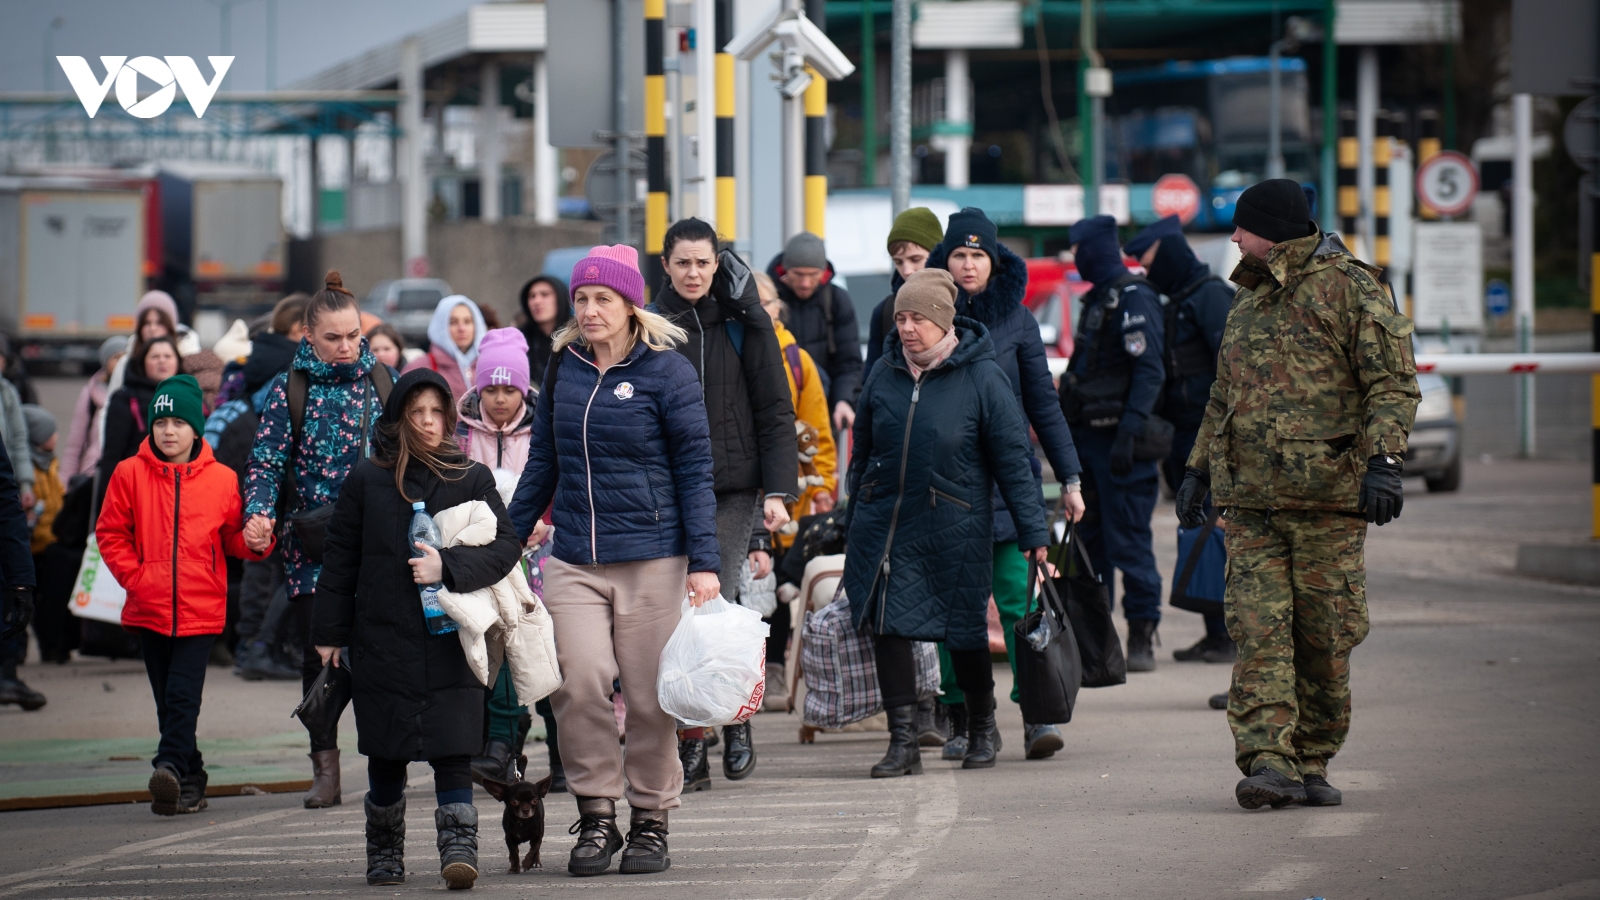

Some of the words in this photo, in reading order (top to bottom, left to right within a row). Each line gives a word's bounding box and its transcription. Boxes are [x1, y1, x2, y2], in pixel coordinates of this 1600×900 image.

[1437, 167, 1458, 198] 5
[490, 366, 511, 386] A4
[154, 394, 173, 414] A4
